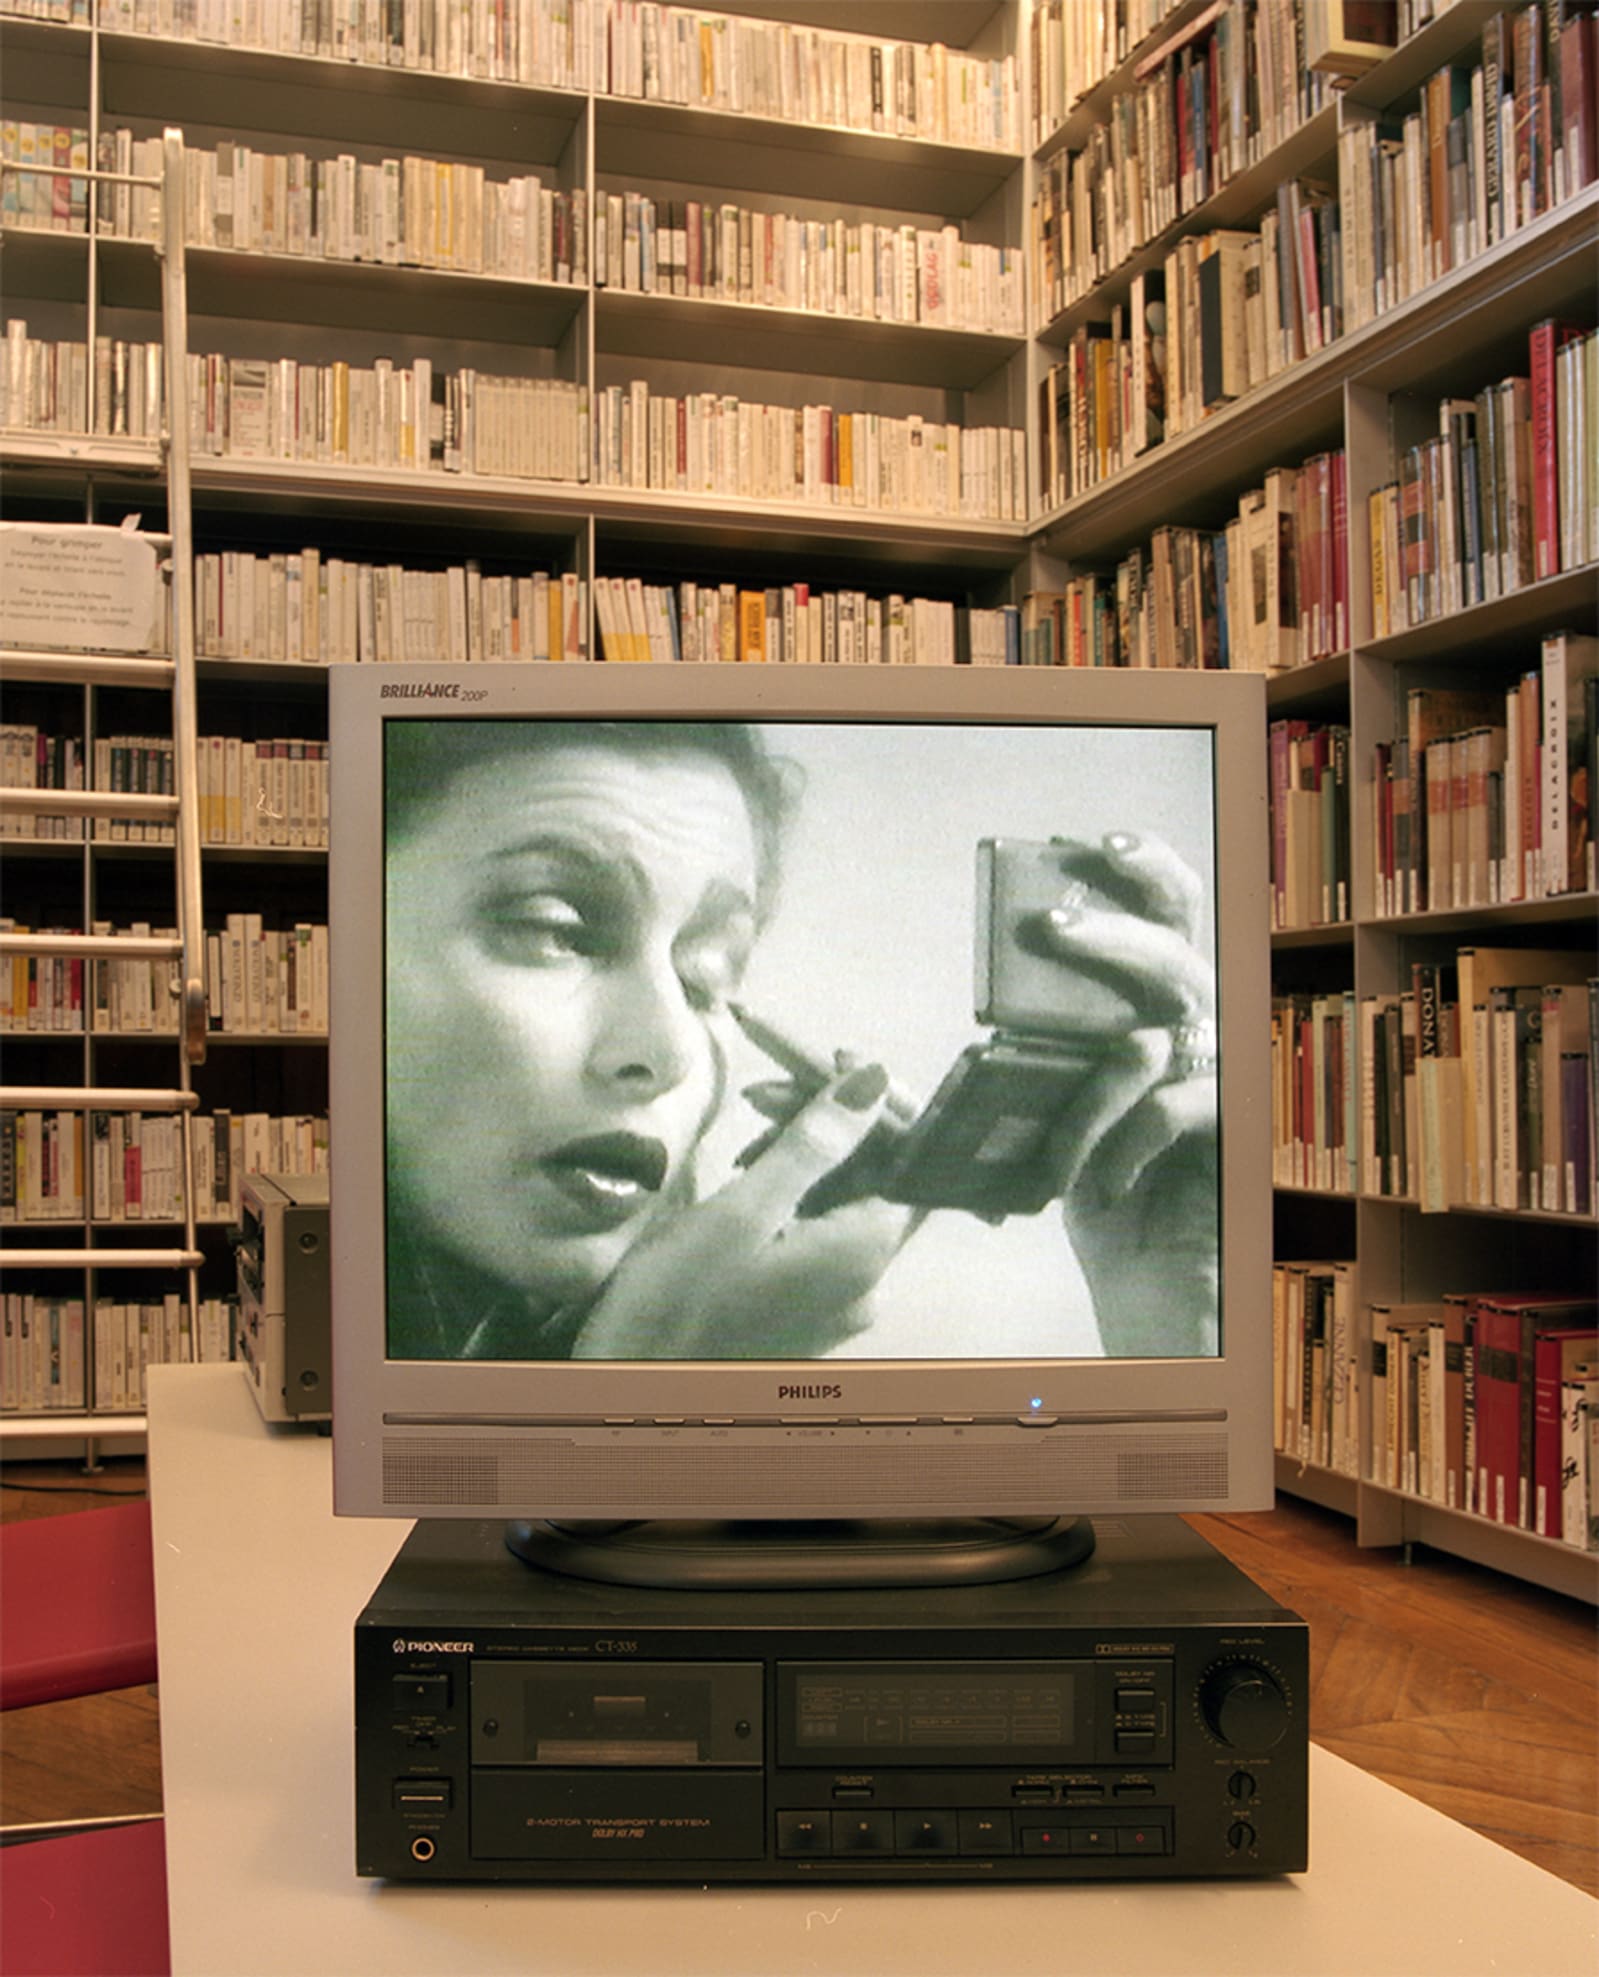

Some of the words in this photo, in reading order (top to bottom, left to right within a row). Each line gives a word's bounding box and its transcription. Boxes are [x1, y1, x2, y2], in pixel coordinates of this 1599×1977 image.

[1536, 331, 1551, 456] DELACROIX
[1373, 538, 1383, 596] DEGAS
[380, 682, 461, 699] BRILLIANCE
[461, 690, 488, 701] 200P
[778, 1384, 842, 1399] PHILIPS
[407, 1641, 475, 1653] PIONEER
[585, 1818, 656, 1827] TRANSPORT
[659, 1818, 711, 1827] SYSTEM
